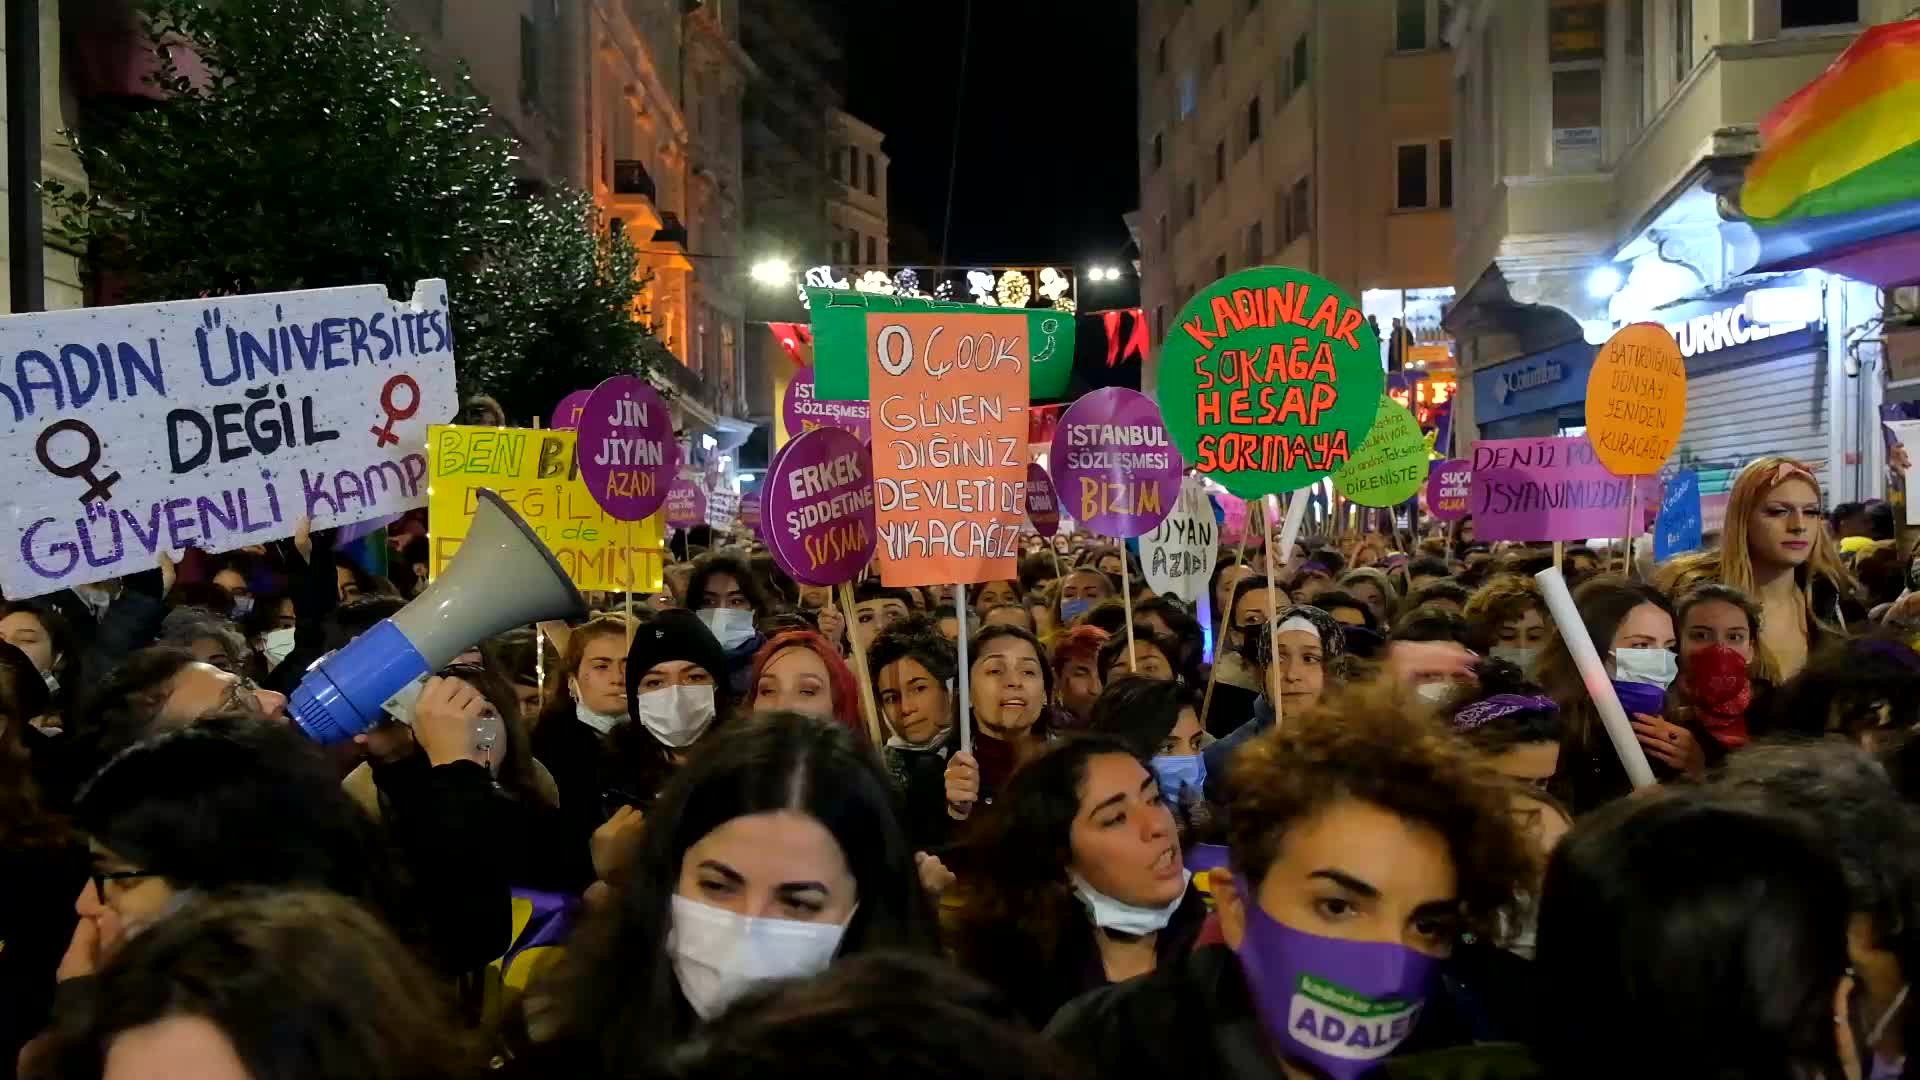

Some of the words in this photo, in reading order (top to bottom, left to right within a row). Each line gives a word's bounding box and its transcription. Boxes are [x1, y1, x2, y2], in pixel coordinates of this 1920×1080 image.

[1182, 281, 1363, 349] KADINLAR
[876, 324, 914, 375] O
[1194, 336, 1337, 389] SOKAĞA
[166, 384, 340, 473] DEĞİL
[608, 391, 648, 428] JİN
[1196, 383, 1337, 426] HESAP
[438, 430, 526, 479] BEN
[595, 430, 663, 465] JİYAN
[1066, 424, 1169, 447] İSTANBUL
[1195, 430, 1351, 473] SORMAYA
[606, 467, 657, 498] AZADİ
[788, 451, 862, 501] ERKEK
[1066, 447, 1169, 474] SÖZLEŞMESİ
[786, 485, 874, 539] ŞİDDETİNE
[1078, 474, 1161, 522] BİZİM
[20, 468, 282, 579] GÜVENLİ
[804, 519, 869, 571] SUSMA
